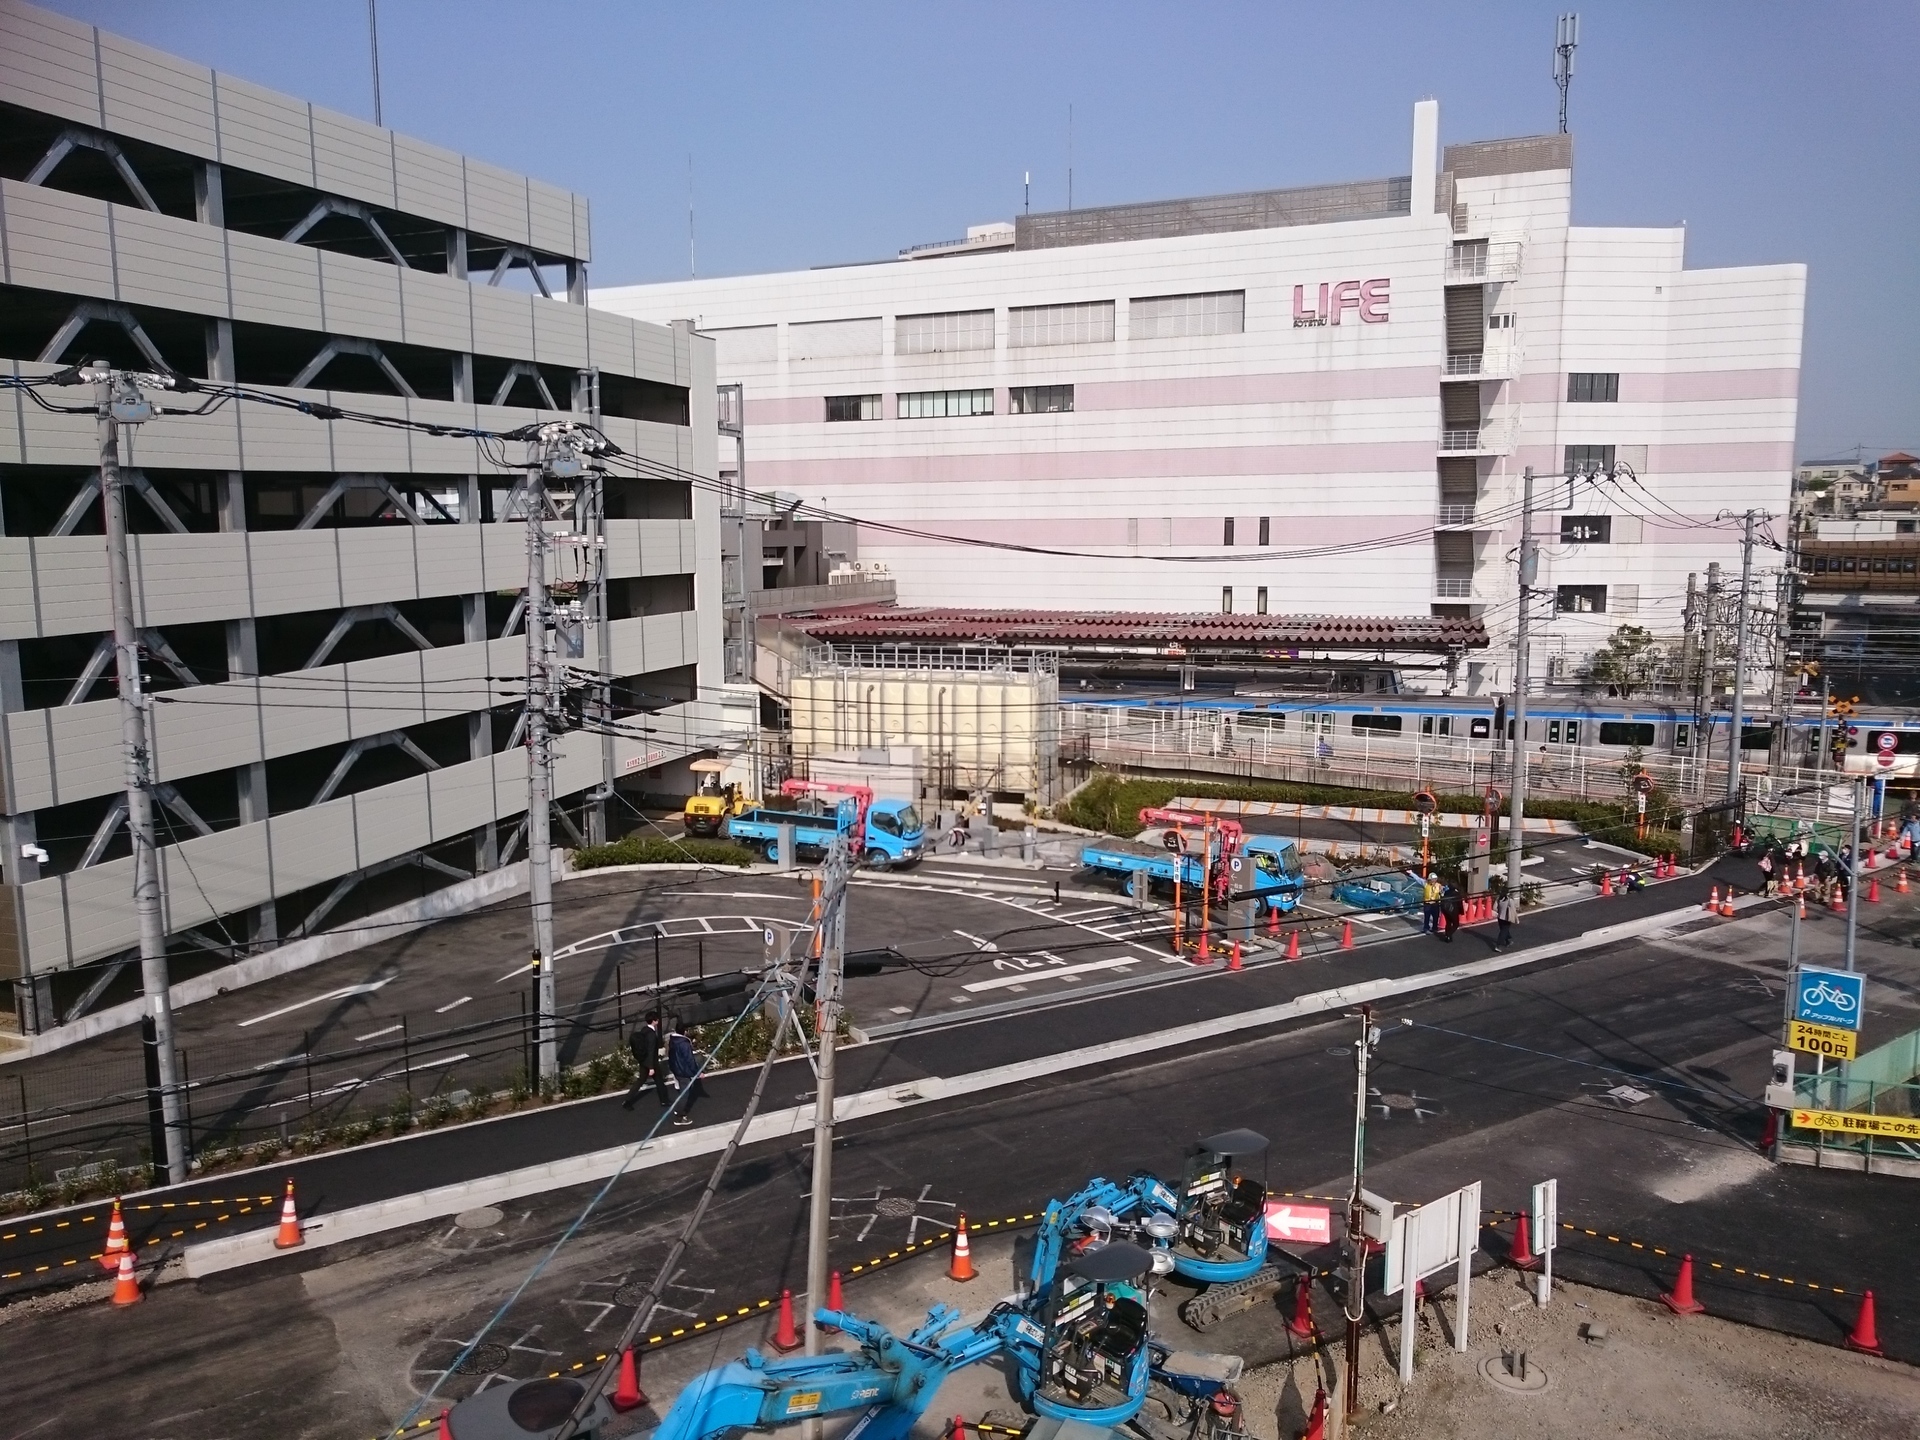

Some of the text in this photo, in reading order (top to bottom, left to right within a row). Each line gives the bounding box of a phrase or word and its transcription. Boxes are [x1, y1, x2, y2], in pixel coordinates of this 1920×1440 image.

[1293, 278, 1391, 326] LIFE
[1796, 1035, 1848, 1057] 100円
[1842, 1117, 1919, 1134] 駐輪場この先
